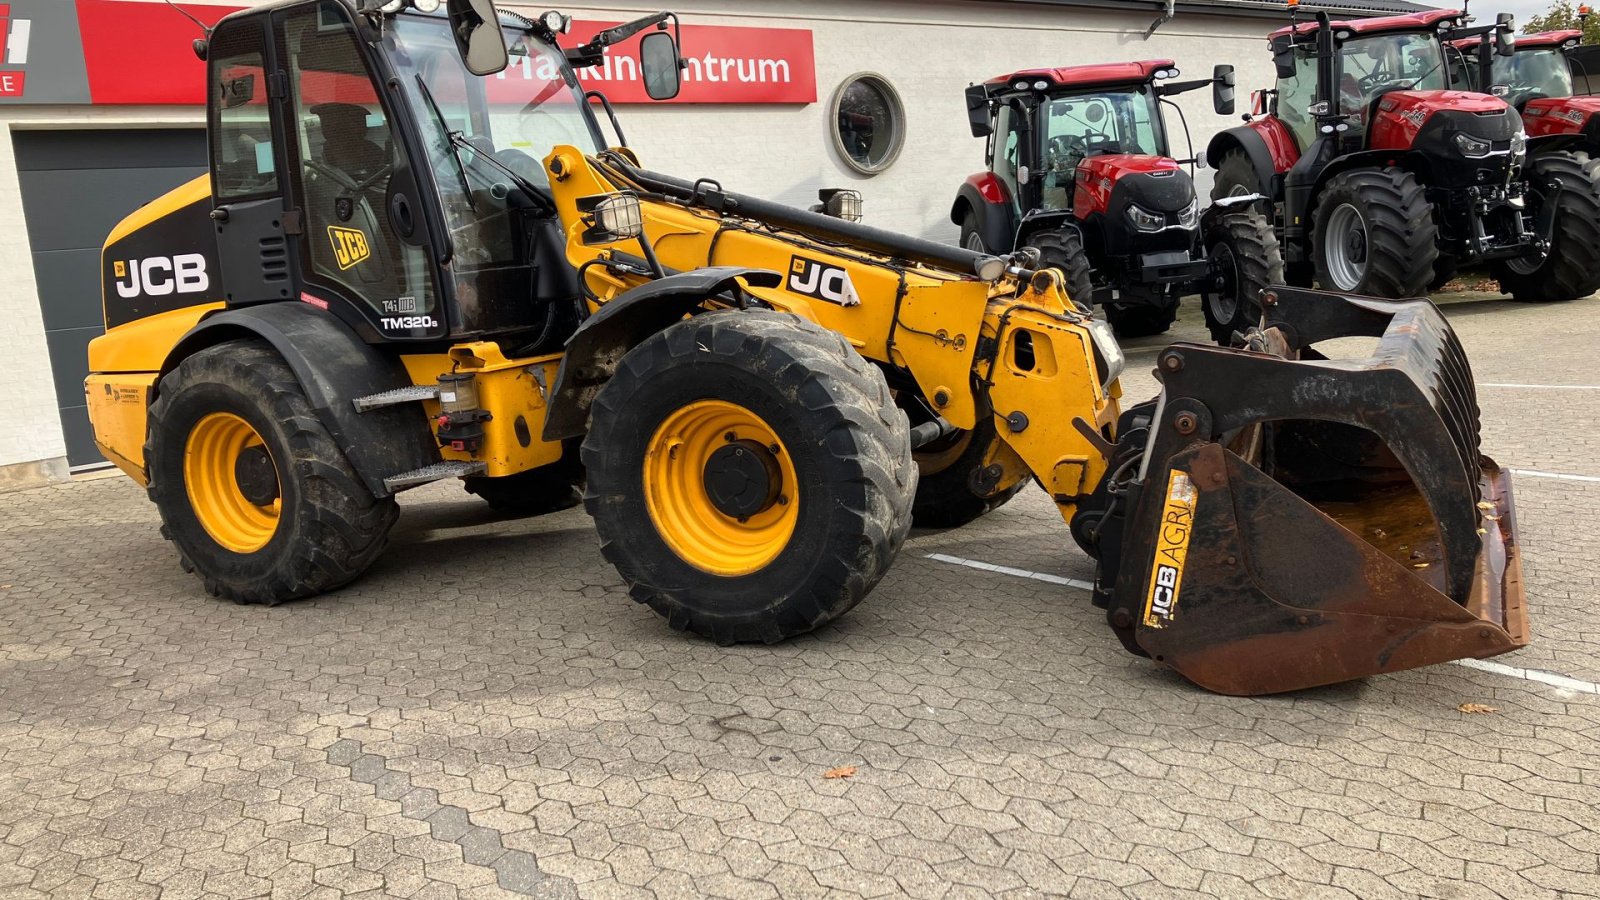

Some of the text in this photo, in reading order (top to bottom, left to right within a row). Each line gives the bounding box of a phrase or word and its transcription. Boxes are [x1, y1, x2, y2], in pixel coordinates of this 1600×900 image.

[335, 230, 368, 265] JCB
[116, 253, 210, 298] JCB
[1152, 504, 1192, 620] JCB AGRI
